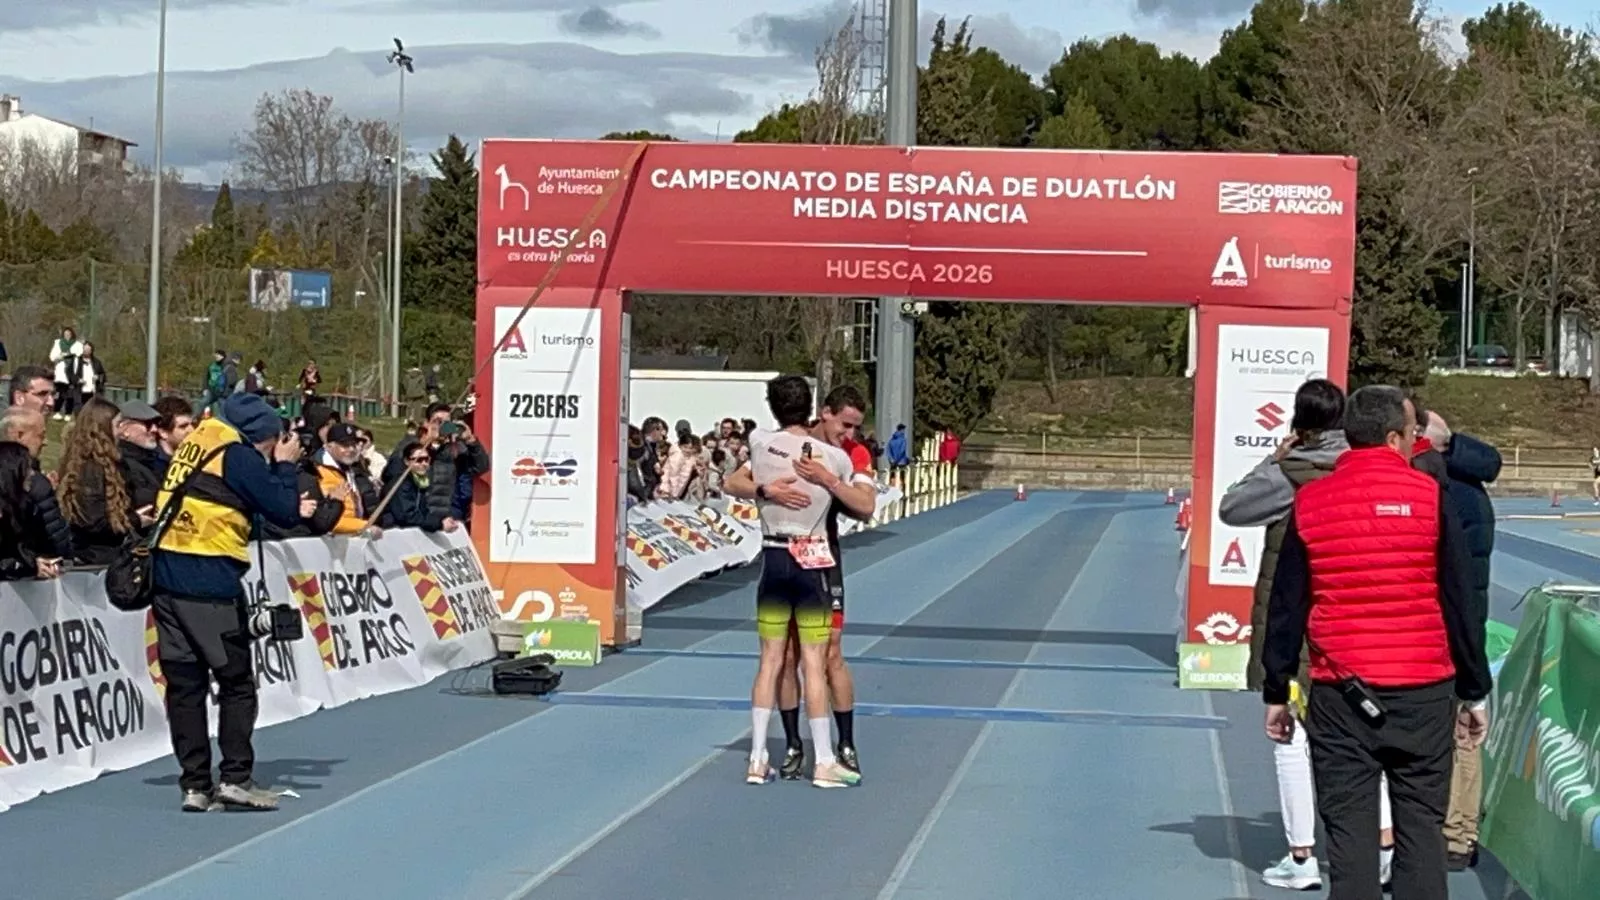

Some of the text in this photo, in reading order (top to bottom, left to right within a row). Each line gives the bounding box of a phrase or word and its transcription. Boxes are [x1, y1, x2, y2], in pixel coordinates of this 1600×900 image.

[538, 166, 628, 181] Ayuntamient
[537, 182, 603, 195] de Huesca
[650, 168, 1176, 200] CAMPEONATO DE ESPAÑA DE DUATLÓN
[1250, 183, 1332, 199] GOBIERNO
[793, 197, 1028, 224] MEDIA DISTANCIA
[1249, 199, 1271, 213] DE
[497, 227, 606, 249] HUESCA
[549, 250, 595, 263] hitoria
[1264, 253, 1332, 270] turismo
[826, 259, 993, 284] HUESCA 2026
[542, 333, 594, 346] turismo
[1231, 347, 1315, 366] HUESCA
[509, 393, 579, 419] 226ERS
[1234, 435, 1283, 448] SUZU
[1188, 672, 1241, 684] IBERDRO
[3, 700, 48, 765] DE
